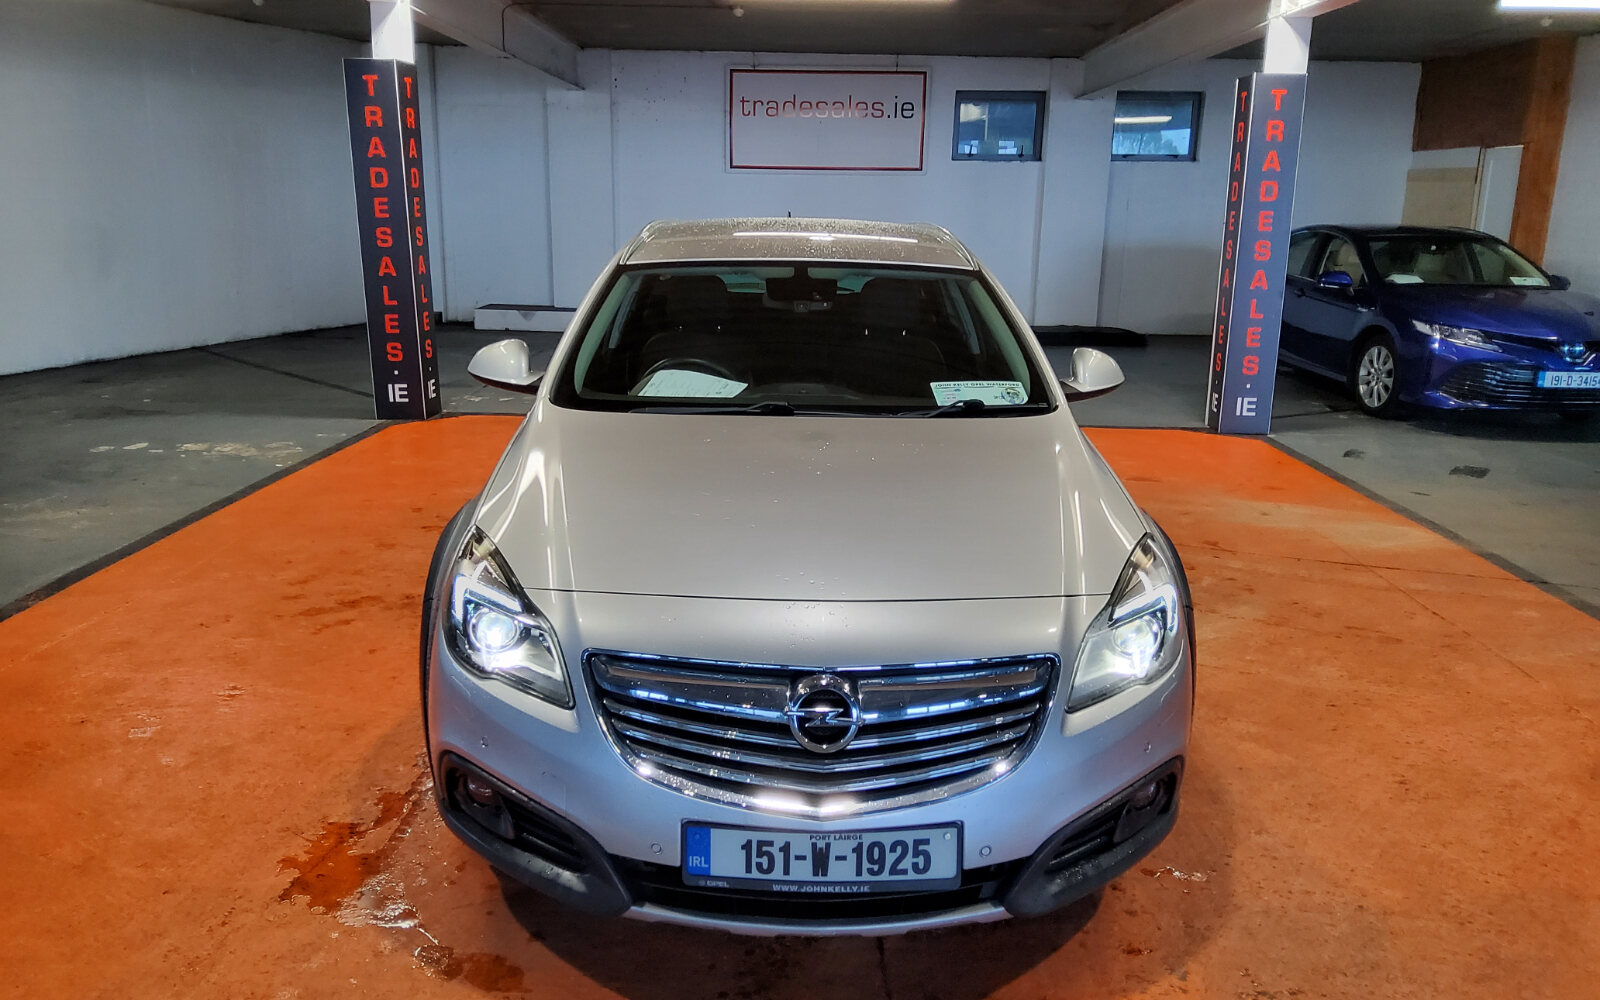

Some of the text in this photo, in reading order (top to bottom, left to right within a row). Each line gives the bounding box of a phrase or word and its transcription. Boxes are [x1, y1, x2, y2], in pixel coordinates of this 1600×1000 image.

[739, 94, 915, 119] tradesales.ie
[688, 857, 709, 868] IRL
[740, 838, 932, 878] 151-W-1925
[772, 883, 871, 893] WWW.JOHNKELLY.IE
